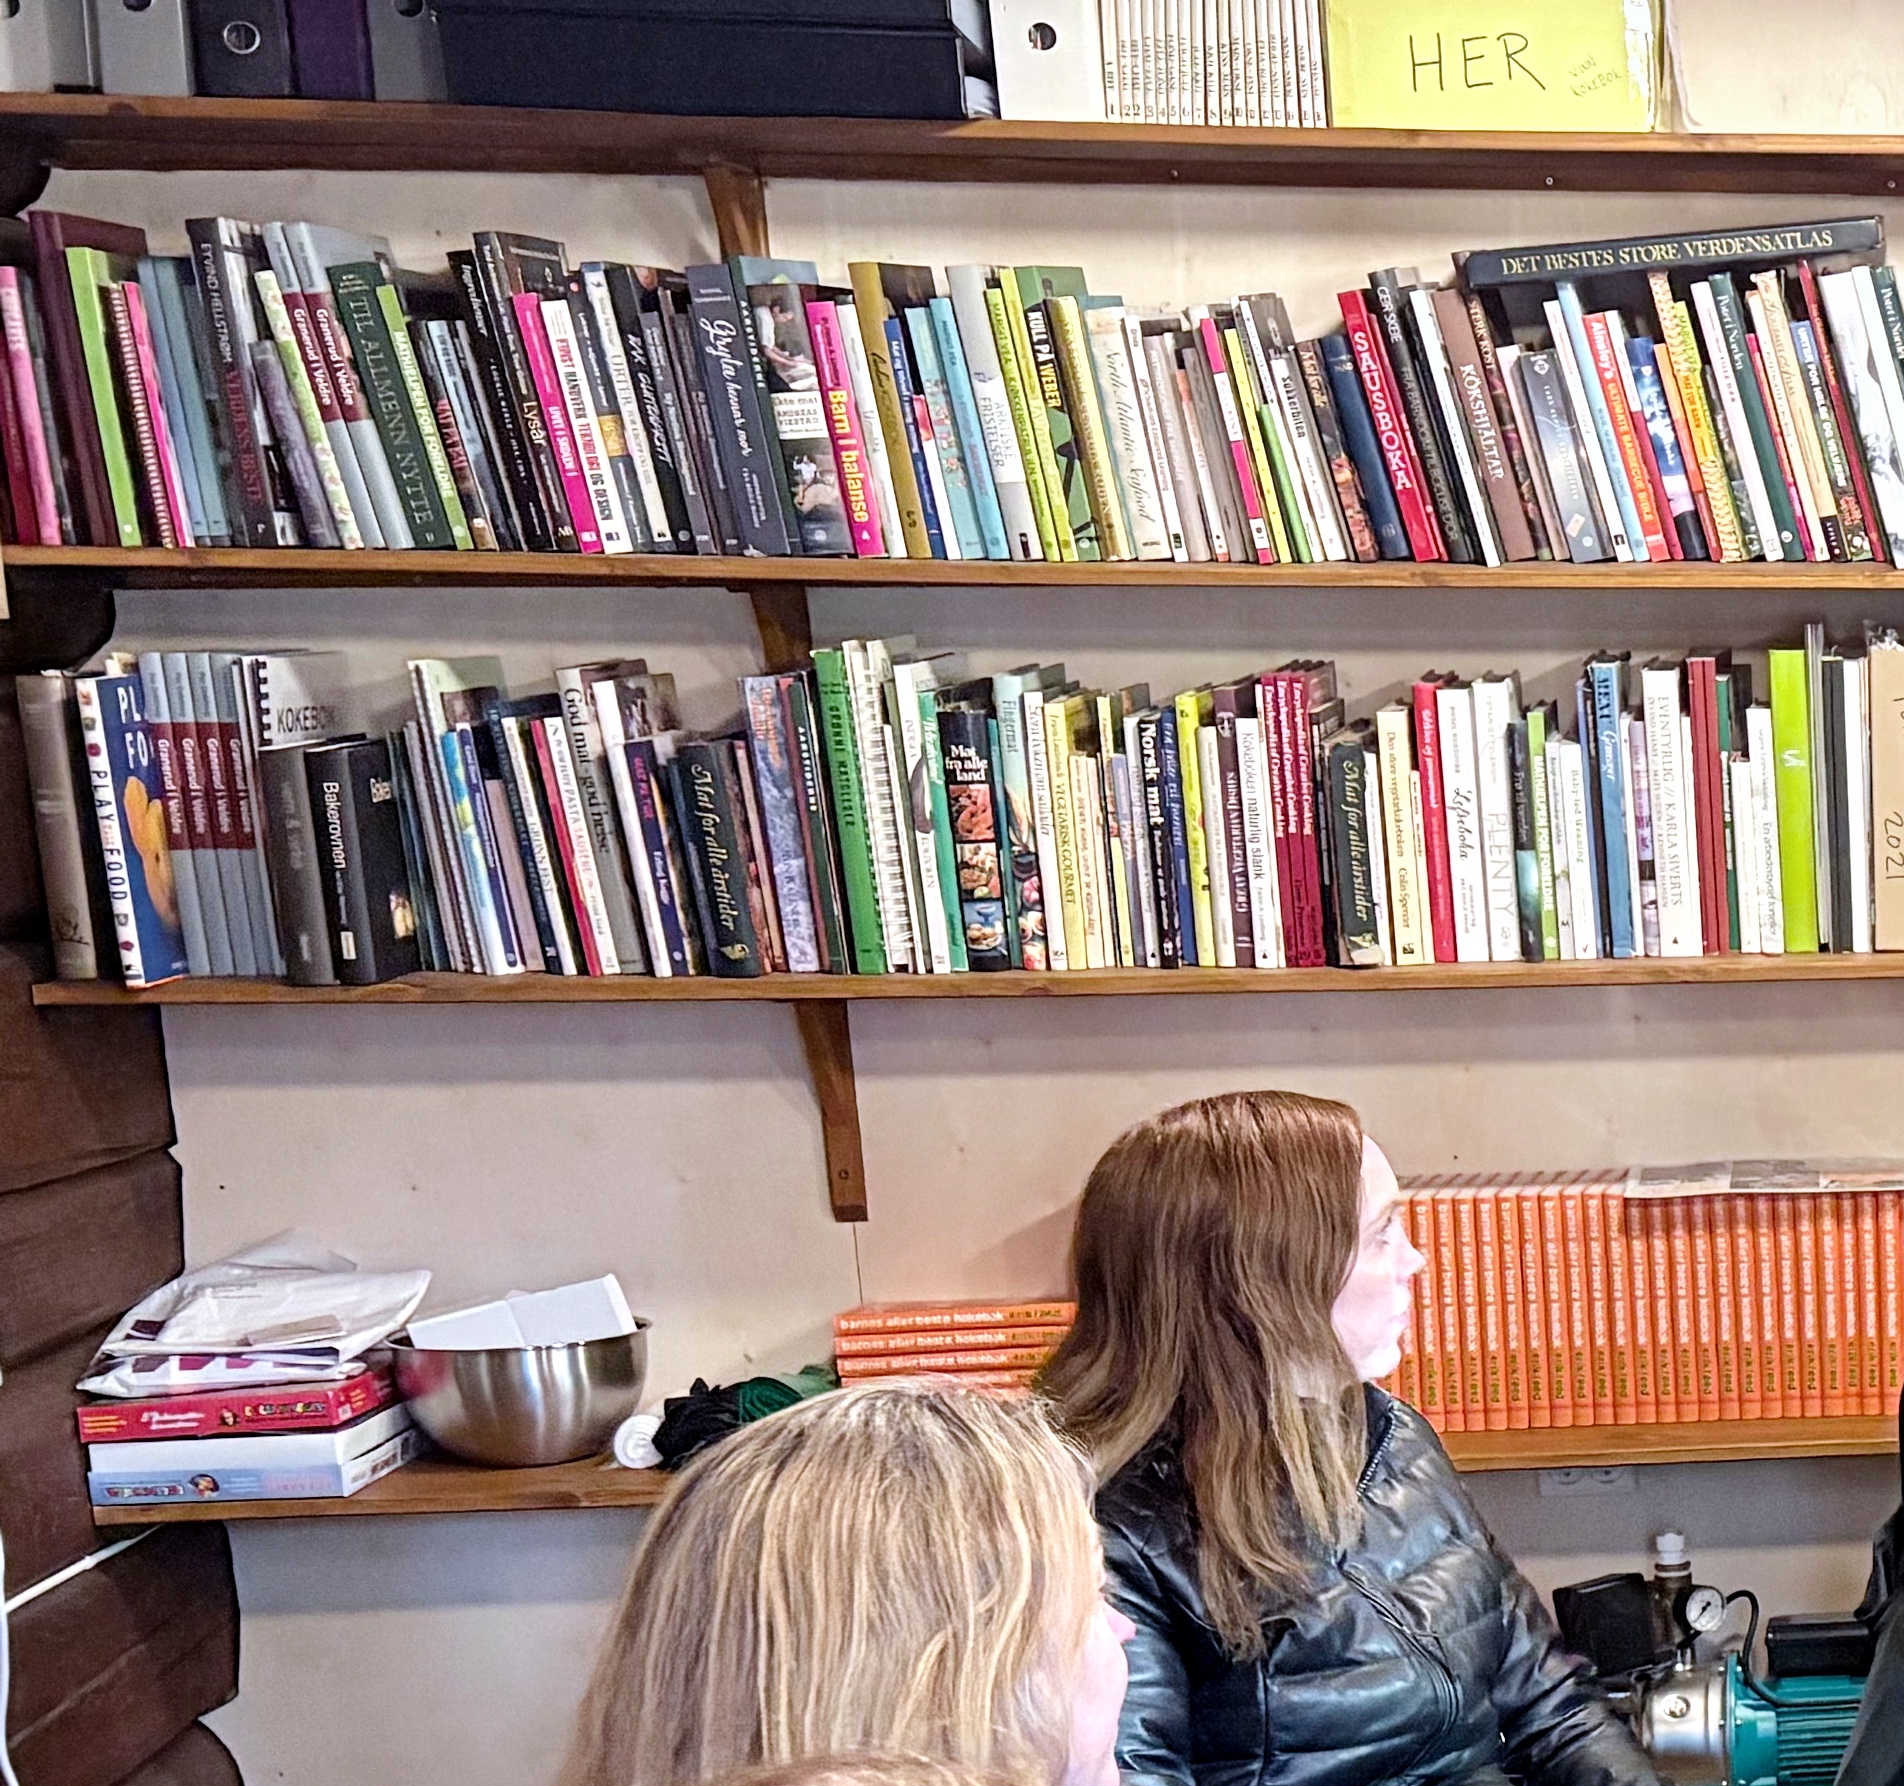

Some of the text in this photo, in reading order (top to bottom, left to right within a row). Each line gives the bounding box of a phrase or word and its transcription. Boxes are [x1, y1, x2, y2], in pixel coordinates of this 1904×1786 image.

[1408, 31, 1545, 92] HER
[201, 244, 220, 288] EYVIND
[1501, 228, 1834, 276] DET BESTES STORE VERDENSATLAS
[208, 292, 232, 363] HELLSTRØM
[1026, 311, 1050, 342] KULL
[1034, 344, 1057, 362] PÅ
[1468, 300, 1495, 370] STERK KOST
[349, 296, 433, 524] TIL ALLMENN NYTTE
[393, 331, 425, 407] MATHJELPEN
[413, 409, 435, 434] FOR
[1038, 364, 1062, 408] WEBER
[1353, 331, 1413, 491] SAUSBOKA
[1796, 327, 1847, 488] URTER FOR HELSE OG VELVÆRE
[555, 338, 613, 521] KUNST HÅNDVERK TEKNOLOGI OG DESIGN
[979, 397, 1004, 468] FRISTELSER
[1104, 349, 1155, 522] North Atlantic Seafood
[1458, 364, 1504, 481] KÖKSHJÄLTAR
[1590, 322, 1654, 522] Ainsley's ULTIMATE BARBECUE BIBLE
[1001, 700, 1018, 754] Fingermat
[1263, 685, 1281, 749] Encyclopedia
[1387, 732, 1397, 750] Den
[1657, 696, 1675, 783] EVENTYRLIG
[949, 745, 975, 758] Mat
[956, 770, 985, 782] land
[963, 758, 988, 770] alle
[1139, 723, 1164, 825] Norsk mat
[1270, 759, 1284, 796] Creative
[90, 769, 129, 901] PLAY FOOD
[322, 782, 347, 869] Bakerovnen
[689, 764, 738, 931] Mat for alle årstider
[1273, 797, 1287, 838] Cooking
[1341, 761, 1370, 922] Mat for alle årstider
[1448, 787, 1473, 860] Lefseboka
[1574, 819, 1586, 864] Weaning
[1664, 803, 1678, 850] KARLA
[1398, 867, 1409, 891] Colin
[1488, 812, 1514, 917] PLENTY
[1667, 854, 1682, 906] SIVERTS
[1398, 892, 1412, 929] Spencer
